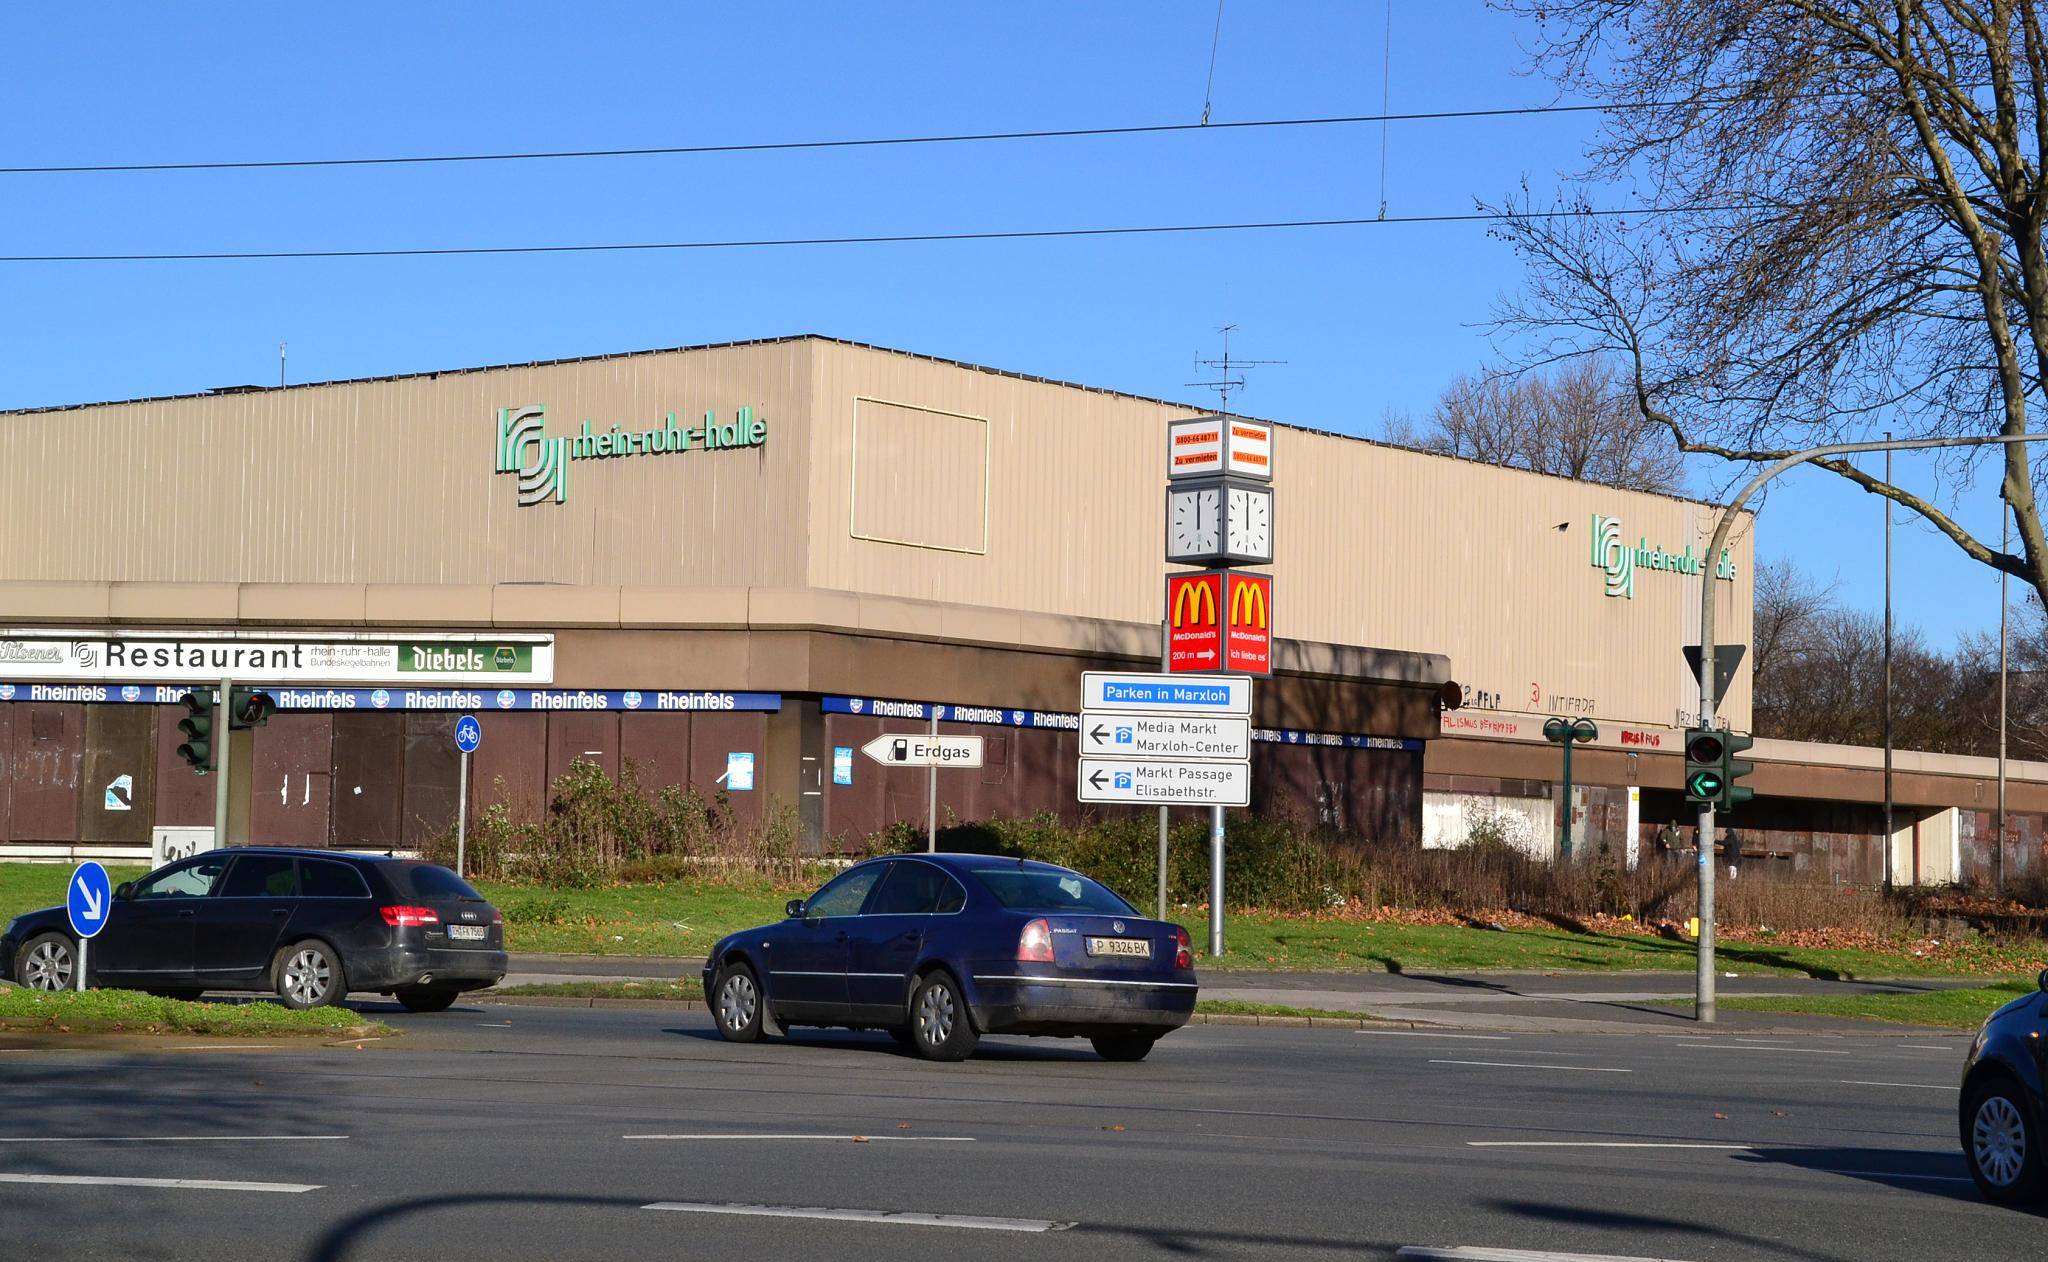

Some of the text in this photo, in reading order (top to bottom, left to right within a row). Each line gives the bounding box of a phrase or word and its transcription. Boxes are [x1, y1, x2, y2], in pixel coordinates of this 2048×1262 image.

[572, 406, 767, 460] rhein-ruhr-halle
[1175, 453, 1217, 465] Zu vermieten
[1635, 536, 1737, 582] rhein-ruhr-alle
[1173, 631, 1216, 641] McDonald's
[1230, 631, 1266, 642] McDonald's
[1, 641, 303, 668] Pilsener Restaurant
[412, 645, 484, 671] Diebels
[1172, 651, 1186, 660] 200
[1241, 650, 1257, 660] liebe
[310, 658, 391, 668] Bundeskegelbahnen
[31, 685, 106, 701] Rheinfels
[280, 690, 356, 708] Rheinfels
[405, 691, 482, 708] Rheinfels
[531, 691, 607, 709] Rheinfels
[657, 692, 735, 710] Rheinfels
[1106, 686, 1226, 701] Parken in Marxloh
[1549, 693, 1595, 714] INTIFADA
[873, 700, 923, 718] Rheinfels
[954, 706, 1002, 723] Rheinfels
[1033, 711, 1079, 729] Rheinfels
[1137, 721, 1217, 735] Media Markt
[914, 744, 970, 760] Erdgas
[1137, 740, 1239, 753] Marxloh-Center
[1136, 767, 1233, 783] Markt Passage
[1136, 785, 1217, 798] Elisabethstr.
[1097, 940, 1148, 954] P 9326 BK
